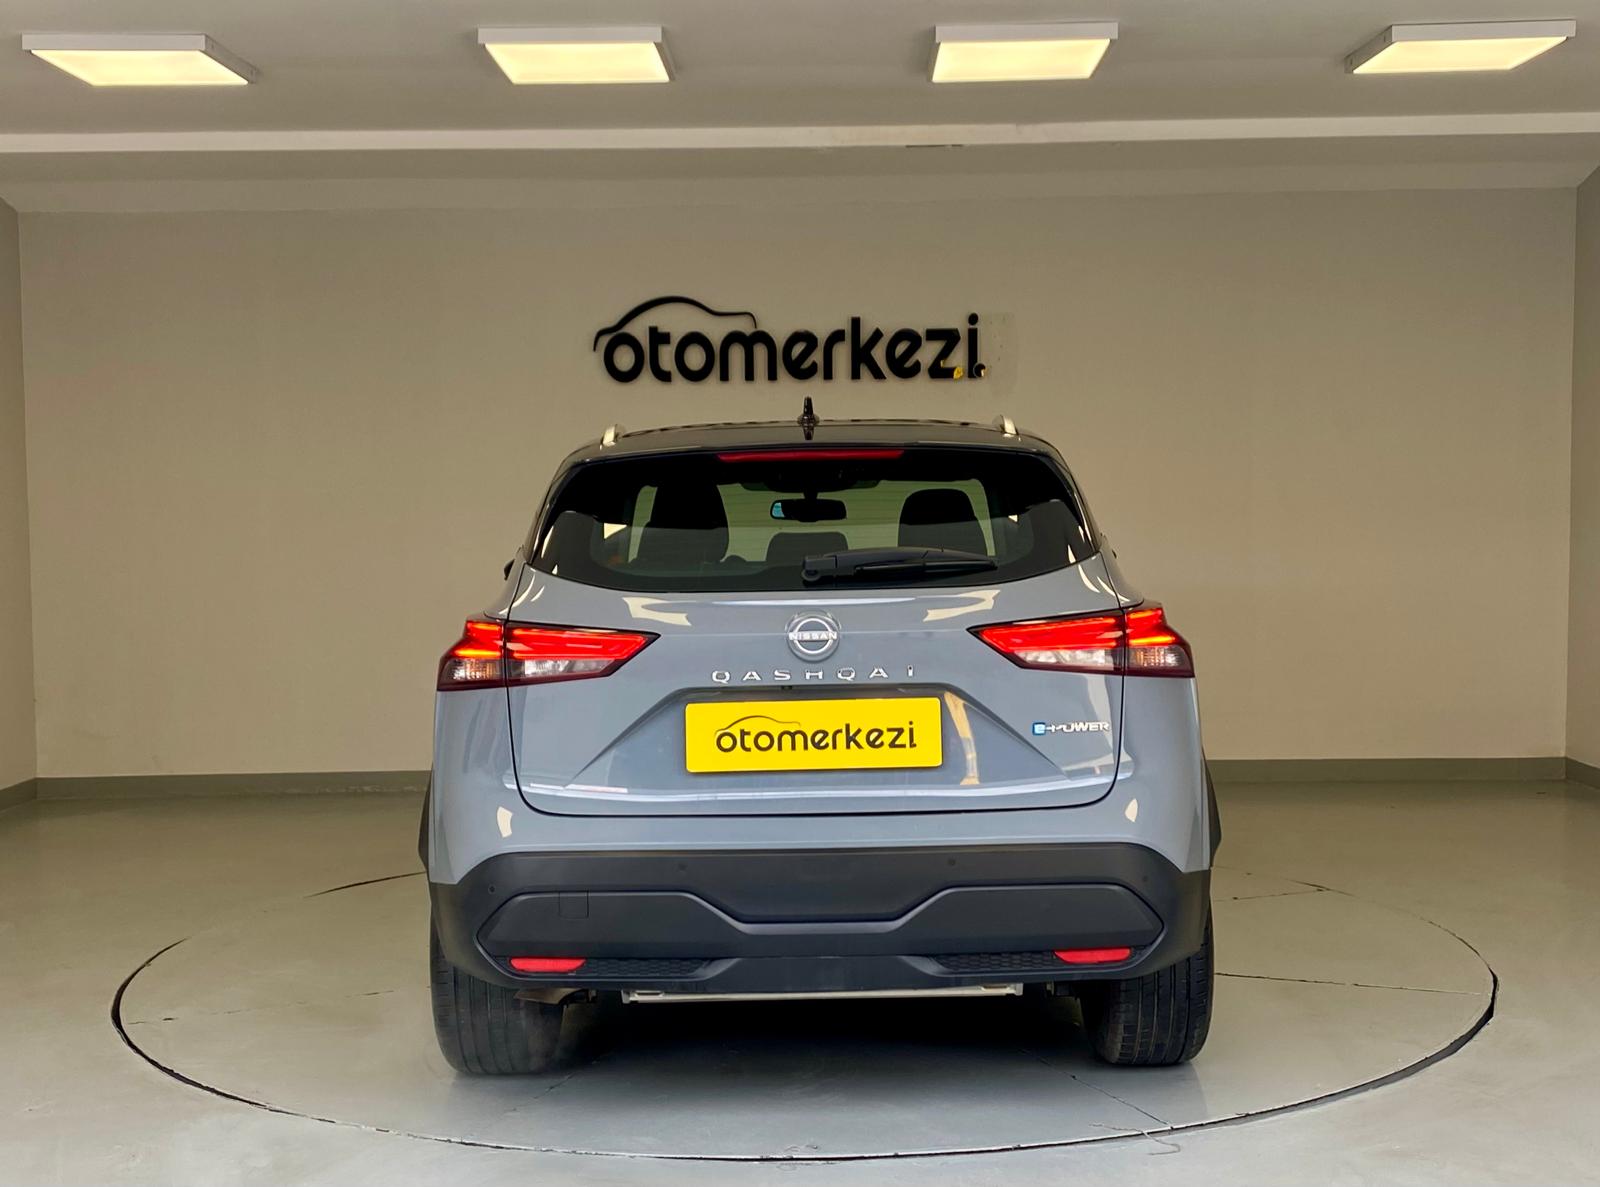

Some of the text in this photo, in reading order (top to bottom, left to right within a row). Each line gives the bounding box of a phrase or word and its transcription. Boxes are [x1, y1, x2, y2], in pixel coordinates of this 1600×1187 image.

[603, 312, 986, 383] otomerkezi
[789, 631, 837, 641] NISSAN
[711, 664, 914, 684] QASHQAI
[715, 721, 917, 753] otomerkezi
